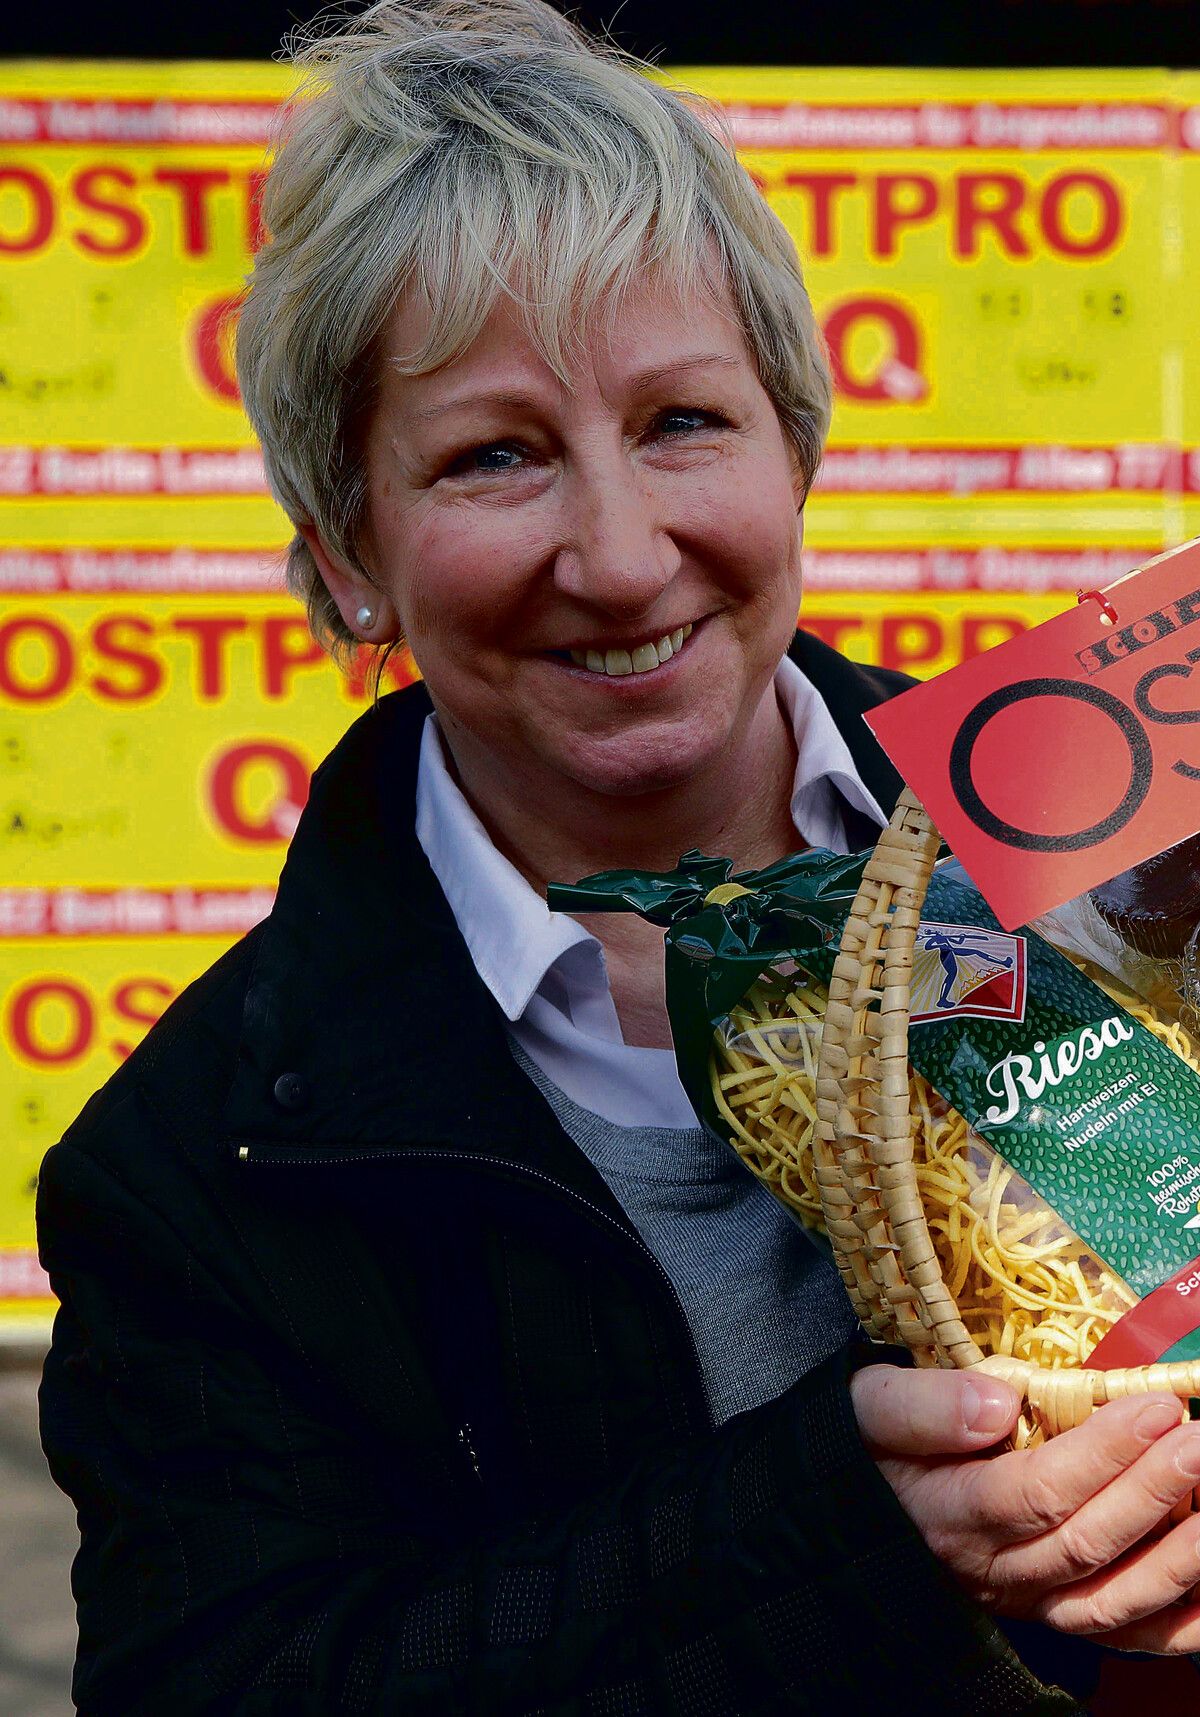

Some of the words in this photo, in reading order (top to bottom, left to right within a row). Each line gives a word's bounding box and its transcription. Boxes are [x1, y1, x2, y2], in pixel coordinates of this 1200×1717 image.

[0, 165, 266, 256] OST
[753, 173, 1123, 258] TPRO
[986, 1016, 1134, 1124] Riesa
[1056, 1072, 1138, 1132] Hartweizen
[1064, 1110, 1119, 1152] Nudeln
[1117, 1094, 1144, 1115] mit
[1139, 1081, 1160, 1097] Ei
[1146, 1154, 1189, 1187] 100%
